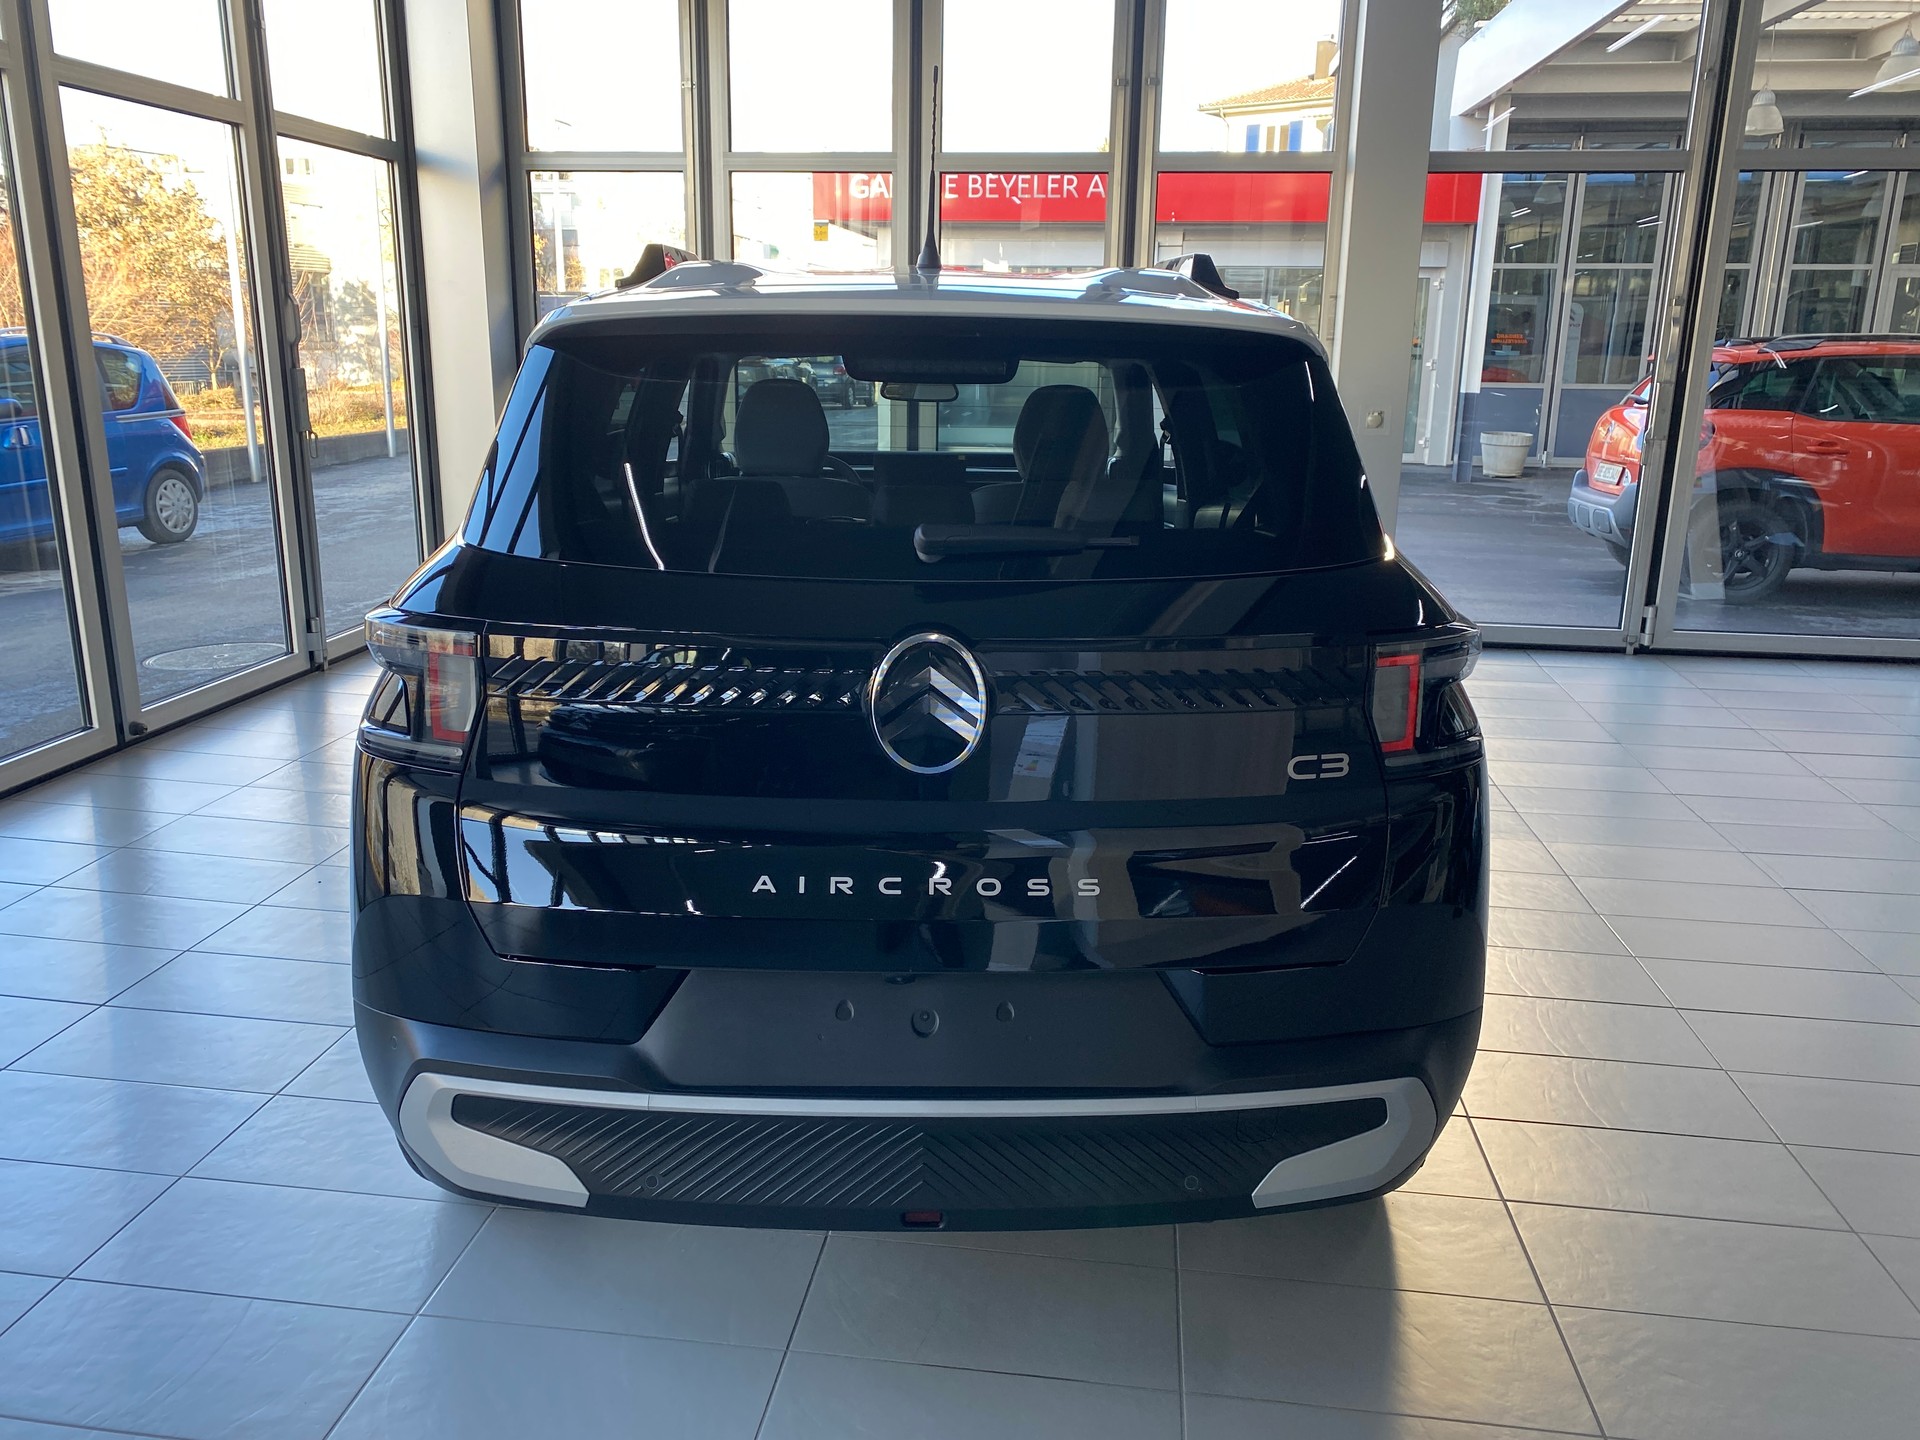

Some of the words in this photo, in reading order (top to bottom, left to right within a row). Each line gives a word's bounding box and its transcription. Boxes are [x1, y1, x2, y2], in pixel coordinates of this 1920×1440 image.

[968, 174, 1079, 199] BEYELER
[1287, 752, 1350, 780] C3
[751, 875, 1102, 897] AIRCROSS
